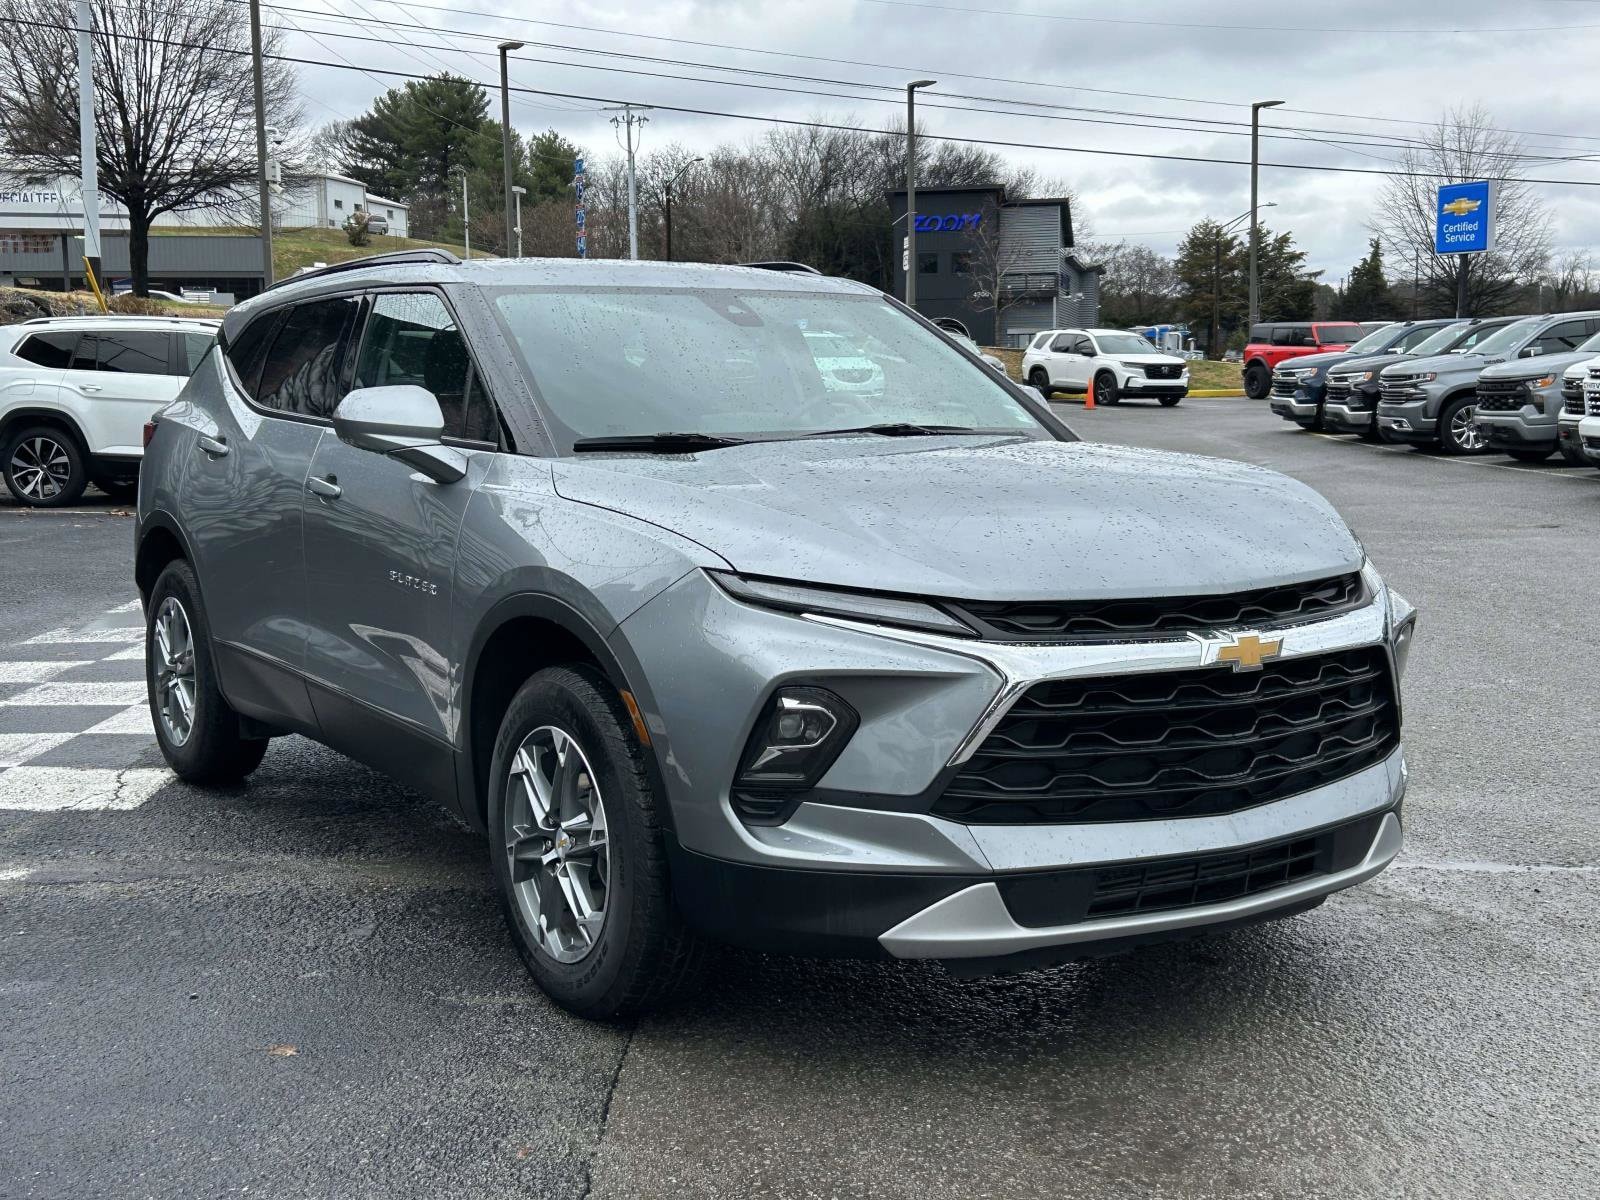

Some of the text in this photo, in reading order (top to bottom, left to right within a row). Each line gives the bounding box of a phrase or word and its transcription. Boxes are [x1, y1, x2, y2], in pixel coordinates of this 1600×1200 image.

[914, 213, 981, 231] ZOOM
[1443, 221, 1479, 233] Certified
[1445, 232, 1475, 243] Service
